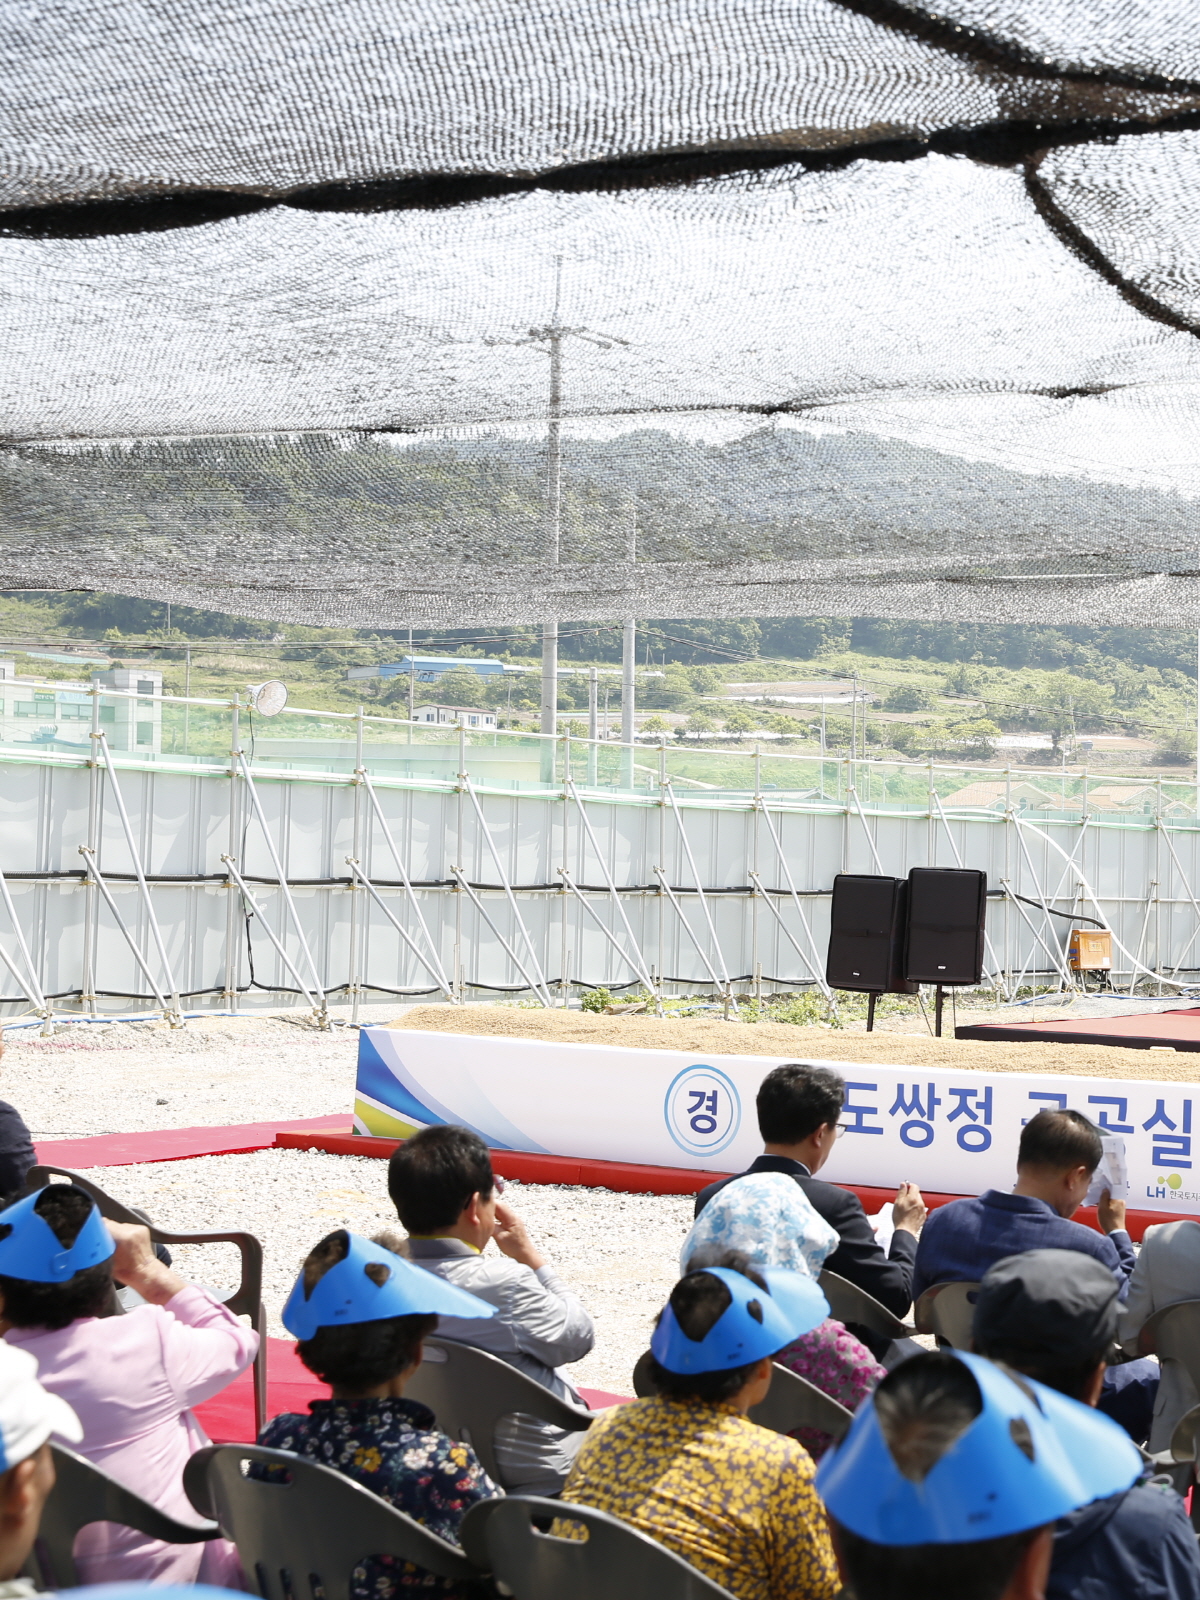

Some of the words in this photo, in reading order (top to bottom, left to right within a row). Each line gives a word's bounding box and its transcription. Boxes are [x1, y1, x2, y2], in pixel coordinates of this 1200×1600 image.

[687, 1090, 719, 1134] 경
[842, 1081, 993, 1153] 도쌍정
[1147, 1185, 1166, 1199] LH
